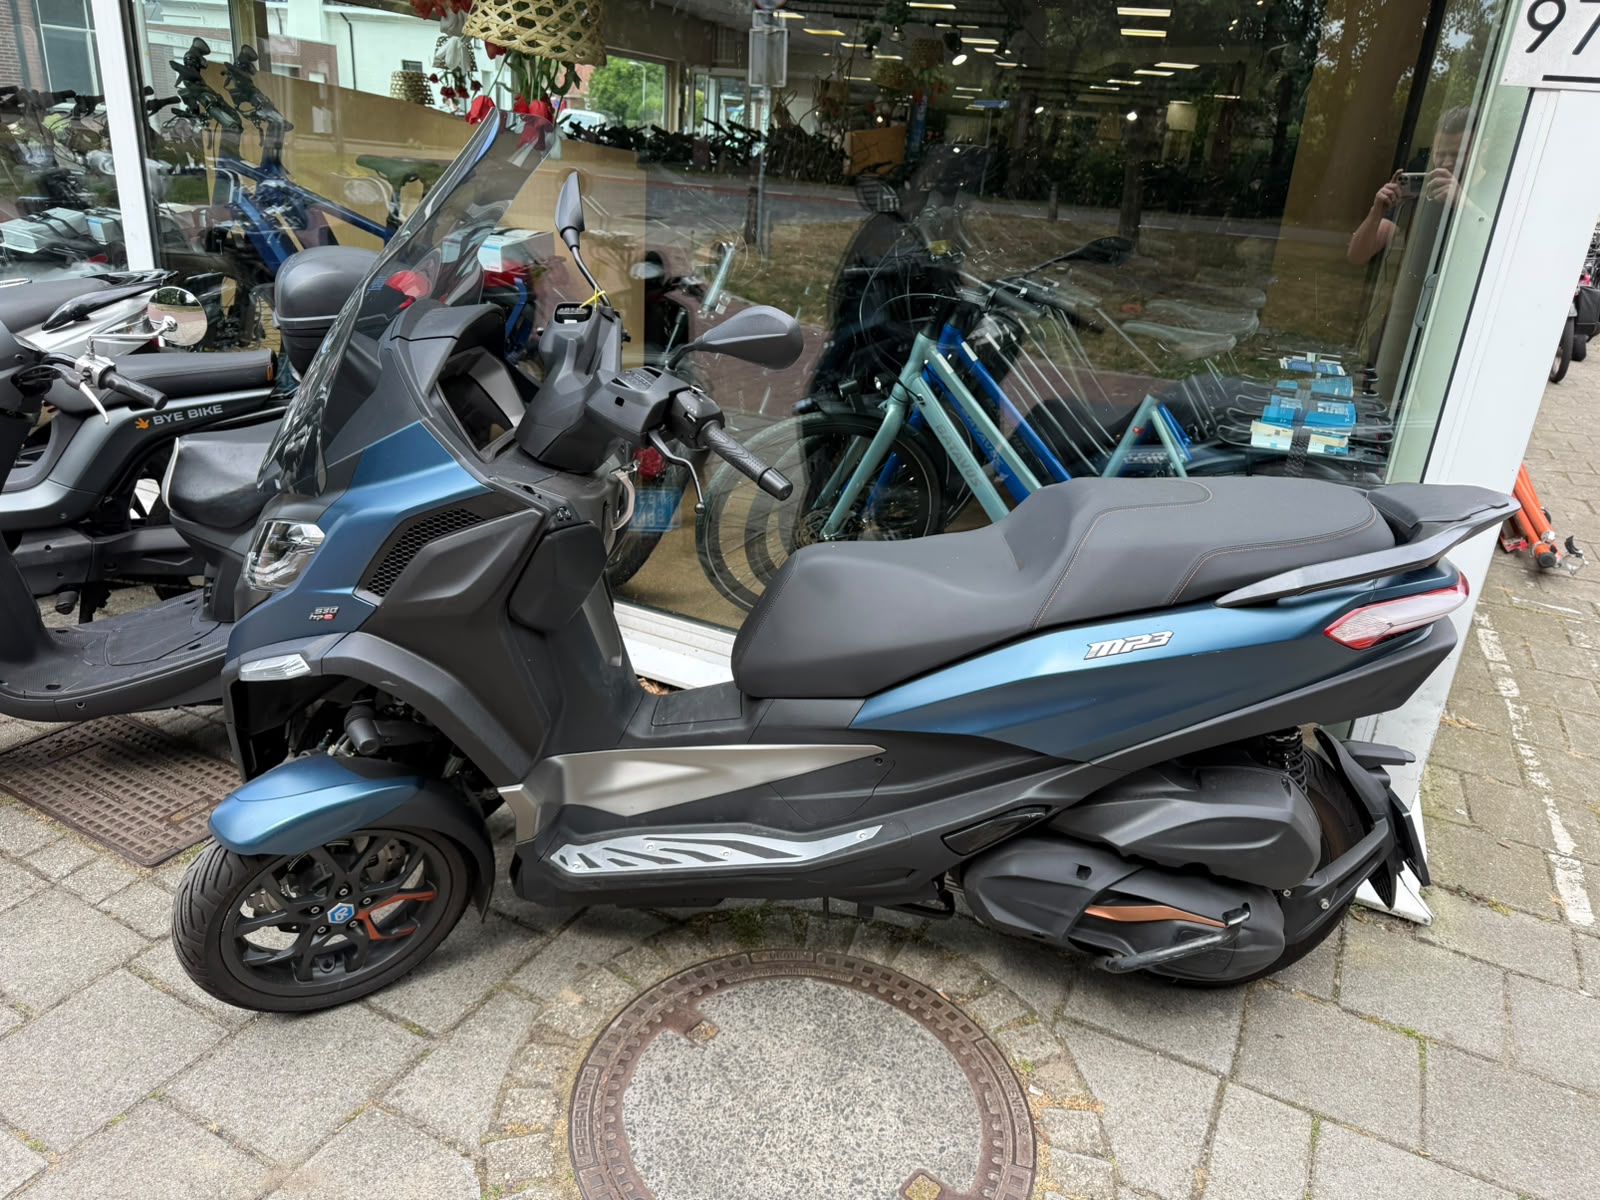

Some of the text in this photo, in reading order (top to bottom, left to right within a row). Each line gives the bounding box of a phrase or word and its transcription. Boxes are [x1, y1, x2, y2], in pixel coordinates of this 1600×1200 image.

[1524, 0, 1600, 56] 97
[152, 404, 223, 425] BYE BIKE
[935, 423, 982, 488] BATAVUS
[1084, 629, 1174, 660] MP3
